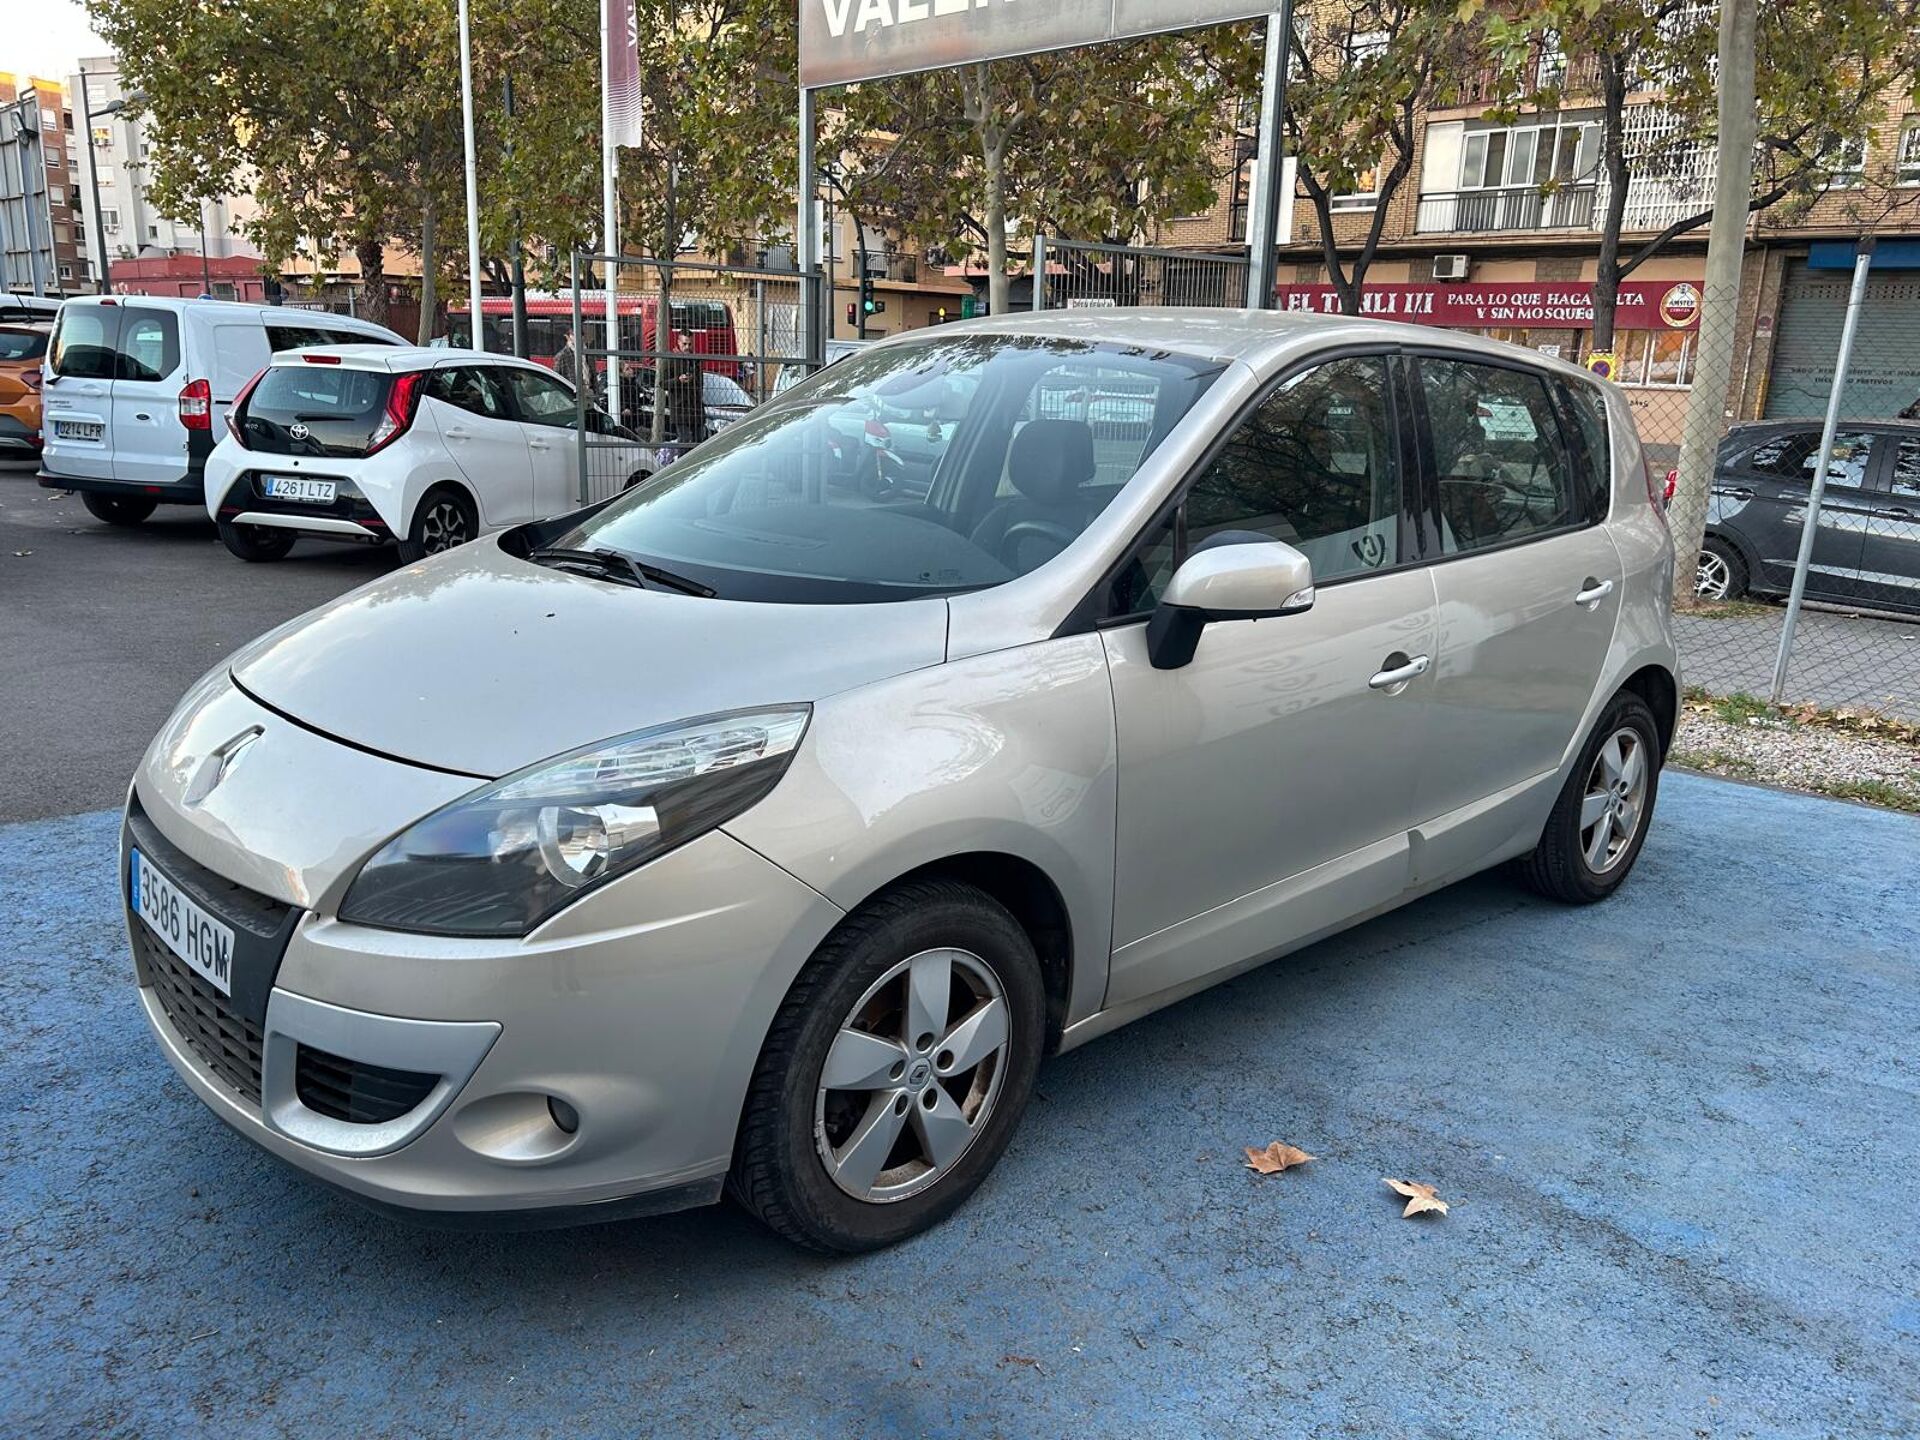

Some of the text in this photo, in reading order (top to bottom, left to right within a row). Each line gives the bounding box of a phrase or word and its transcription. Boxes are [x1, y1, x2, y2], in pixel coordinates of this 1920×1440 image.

[1287, 293, 1314, 312] EL
[1447, 293, 1484, 305] PARA
[1488, 293, 1507, 305] LO
[1511, 293, 1541, 306] QUE
[1547, 293, 1592, 305] HAGA
[1490, 307, 1515, 318] SIN
[59, 421, 102, 437] 0214 LFR
[274, 480, 333, 497] 4261 LTZ
[142, 867, 229, 983] 3586 HGM
